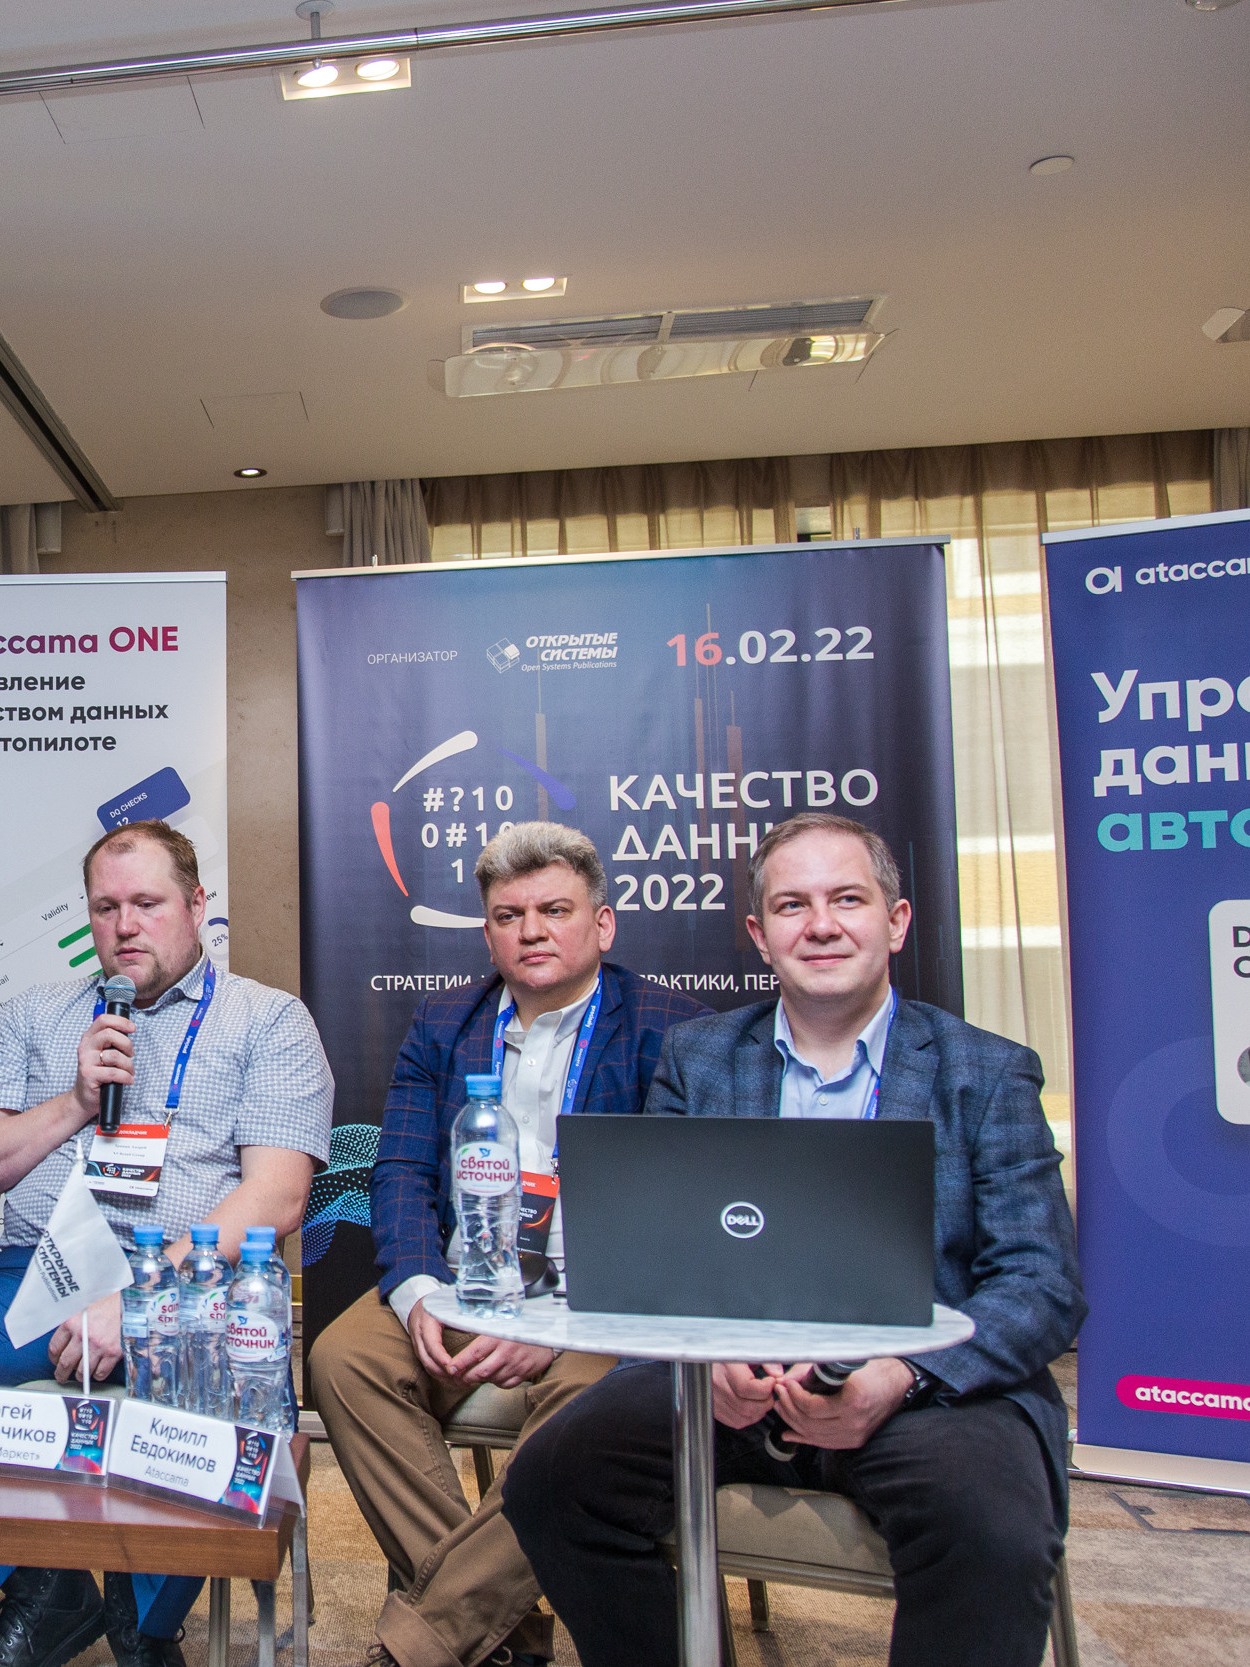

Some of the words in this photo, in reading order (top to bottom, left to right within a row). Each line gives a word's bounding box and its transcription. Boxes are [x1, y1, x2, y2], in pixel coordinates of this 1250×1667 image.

[1135, 557, 1250, 585] atacca
[109, 625, 179, 652] ONE
[525, 632, 618, 648] ОТКРЫТЫЕ
[666, 626, 875, 667] 16.02.22
[367, 650, 458, 665] ОРГАНИЗАТОР
[521, 663, 541, 673] Open
[542, 662, 572, 672] Systems
[573, 660, 618, 670] Publications
[540, 646, 619, 662] СИСТЕМЫ
[70, 703, 169, 725] данных
[1090, 669, 1250, 732] Упр
[1093, 742, 1250, 797] дан
[610, 768, 879, 811] КАЧЕСТВО
[110, 808, 122, 819] DQ
[121, 792, 148, 812] CHECKS
[612, 822, 774, 861] ДАНН
[614, 873, 726, 912] 2022
[41, 902, 70, 921] Validity
[727, 1214, 760, 1226] DELL
[38, 1246, 71, 1299] СИСТЕМЫ
[150, 1416, 208, 1449] Кирилл
[131, 1434, 217, 1474] Евдокимов
[145, 1465, 190, 1487] Ataccama
